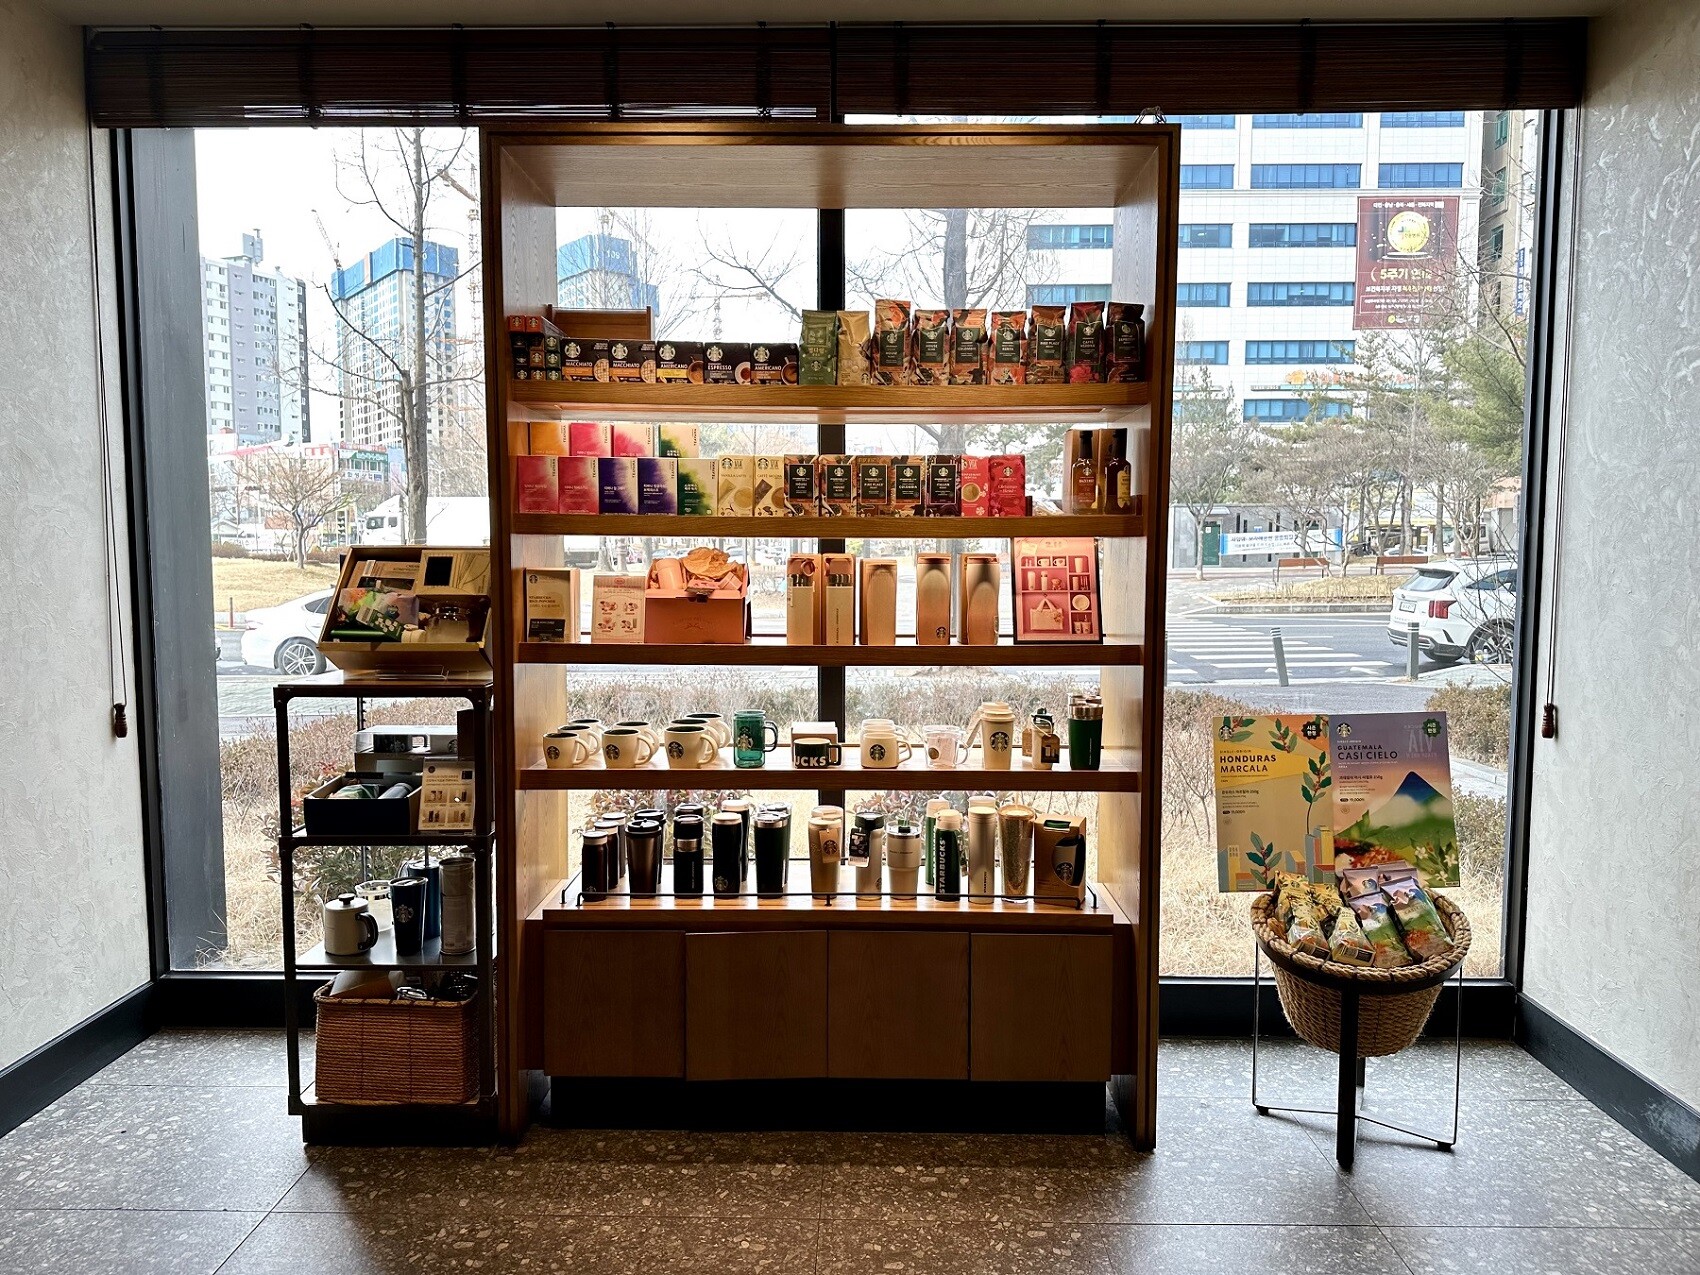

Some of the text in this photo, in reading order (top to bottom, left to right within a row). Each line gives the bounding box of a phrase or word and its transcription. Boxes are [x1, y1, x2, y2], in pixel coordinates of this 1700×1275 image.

[1219, 754, 1277, 763] HONDURAS
[1337, 750, 1398, 760] CASI CIELO
[795, 756, 827, 767] UCKS
[1220, 764, 1268, 773] MARCALA
